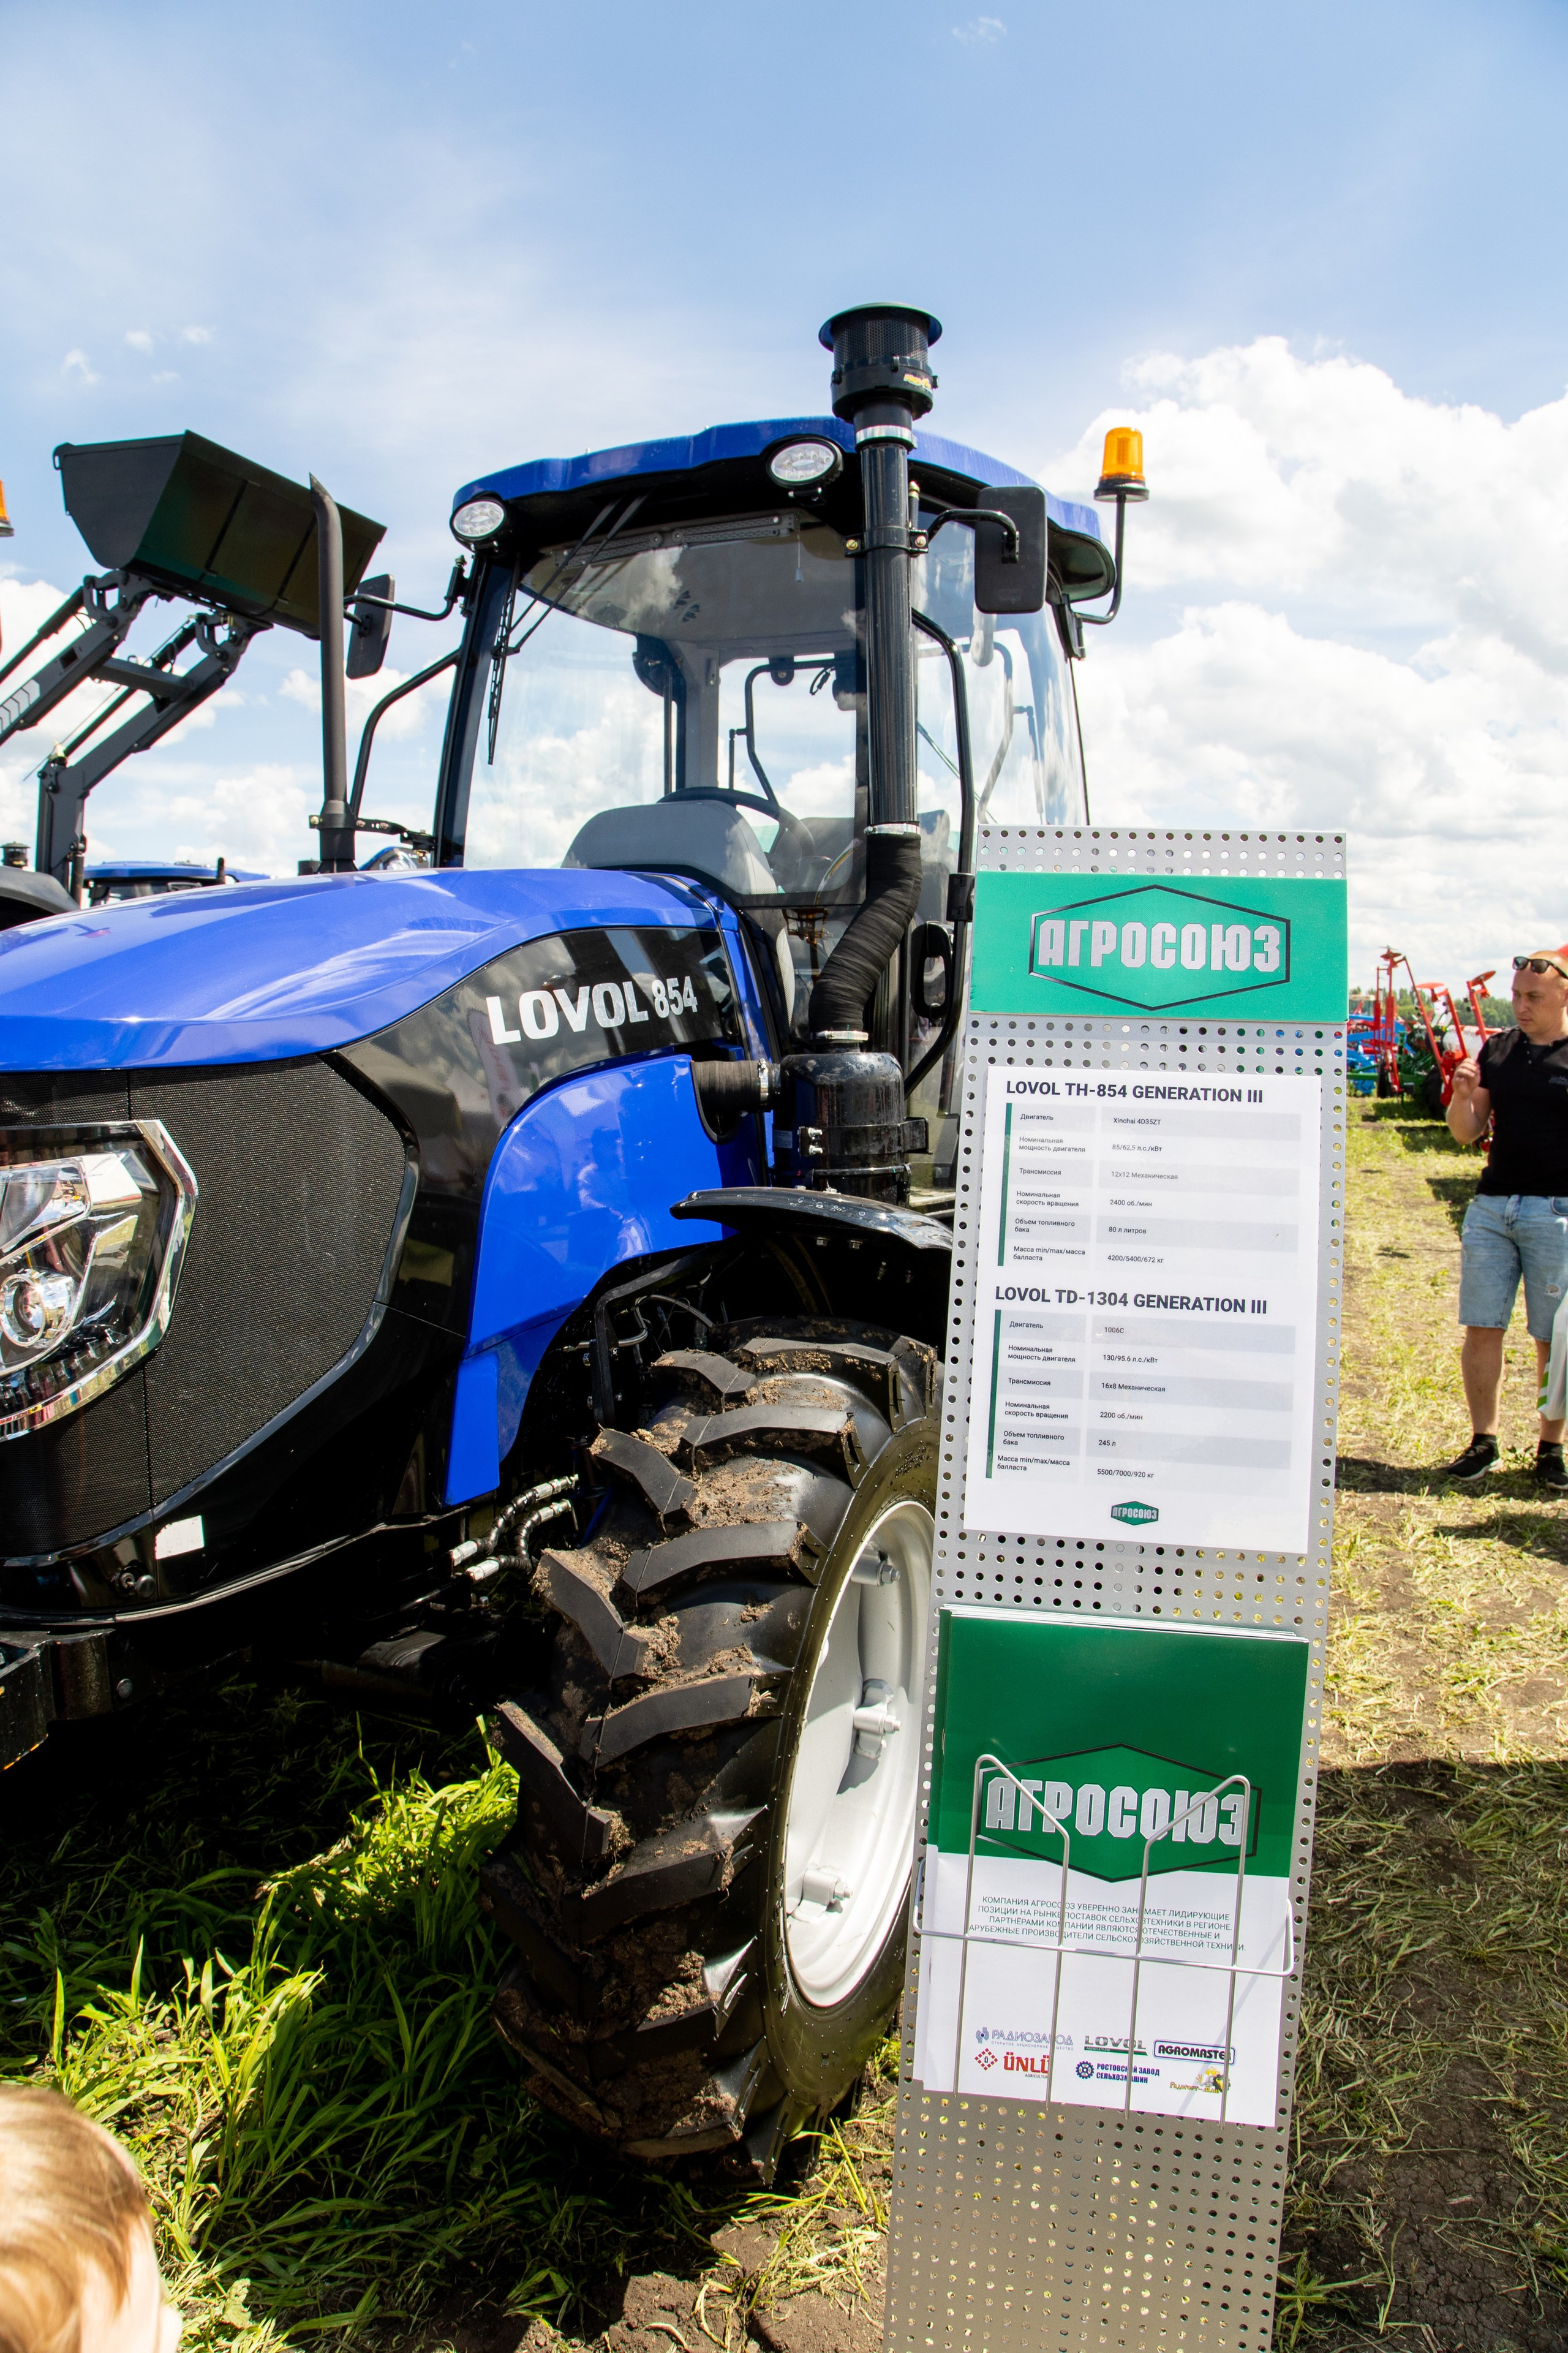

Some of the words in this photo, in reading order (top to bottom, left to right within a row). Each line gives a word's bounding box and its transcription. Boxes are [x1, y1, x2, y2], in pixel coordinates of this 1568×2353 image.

[1038, 920, 1280, 972] АГРОСОЮЗ
[486, 981, 649, 1044] LOVOL
[652, 976, 698, 1018] 854
[1007, 1081, 1060, 1095] LOVOL
[1065, 1083, 1127, 1097] TH-854
[1133, 1086, 1242, 1101] GENERATION
[1248, 1090, 1262, 1103] III
[996, 1286, 1050, 1302] LOVOL
[1055, 1290, 1128, 1306] TD-1304
[1134, 1294, 1245, 1313] GENERATION
[1251, 1300, 1267, 1314] III
[1098, 1469, 1145, 1478] 5500/7000/920
[1112, 1507, 1157, 1519] АГРОСОЮЗ
[986, 1777, 1245, 1845] АГРОСОЮЗ
[978, 1906, 1017, 1915] ПОЗИЦИИ
[983, 1897, 1028, 1906] КОМПАНИЯ
[1077, 1903, 1120, 1913] УВЕРЕННО
[1122, 1906, 1167, 1916] ЗАНМАЕТ
[1169, 1910, 1229, 1921] ЛИДИРУЮЩИЕ
[1142, 1927, 1212, 1939] ОТЕЧЕСТВЕННЫЕ
[1206, 1942, 1246, 1951] ТЕХНИИ.
[992, 2030, 1073, 2045] РАДИОЗАОД
[1085, 2036, 1146, 2049] LOVOL
[1139, 2068, 1159, 2076] ЗАВОД
